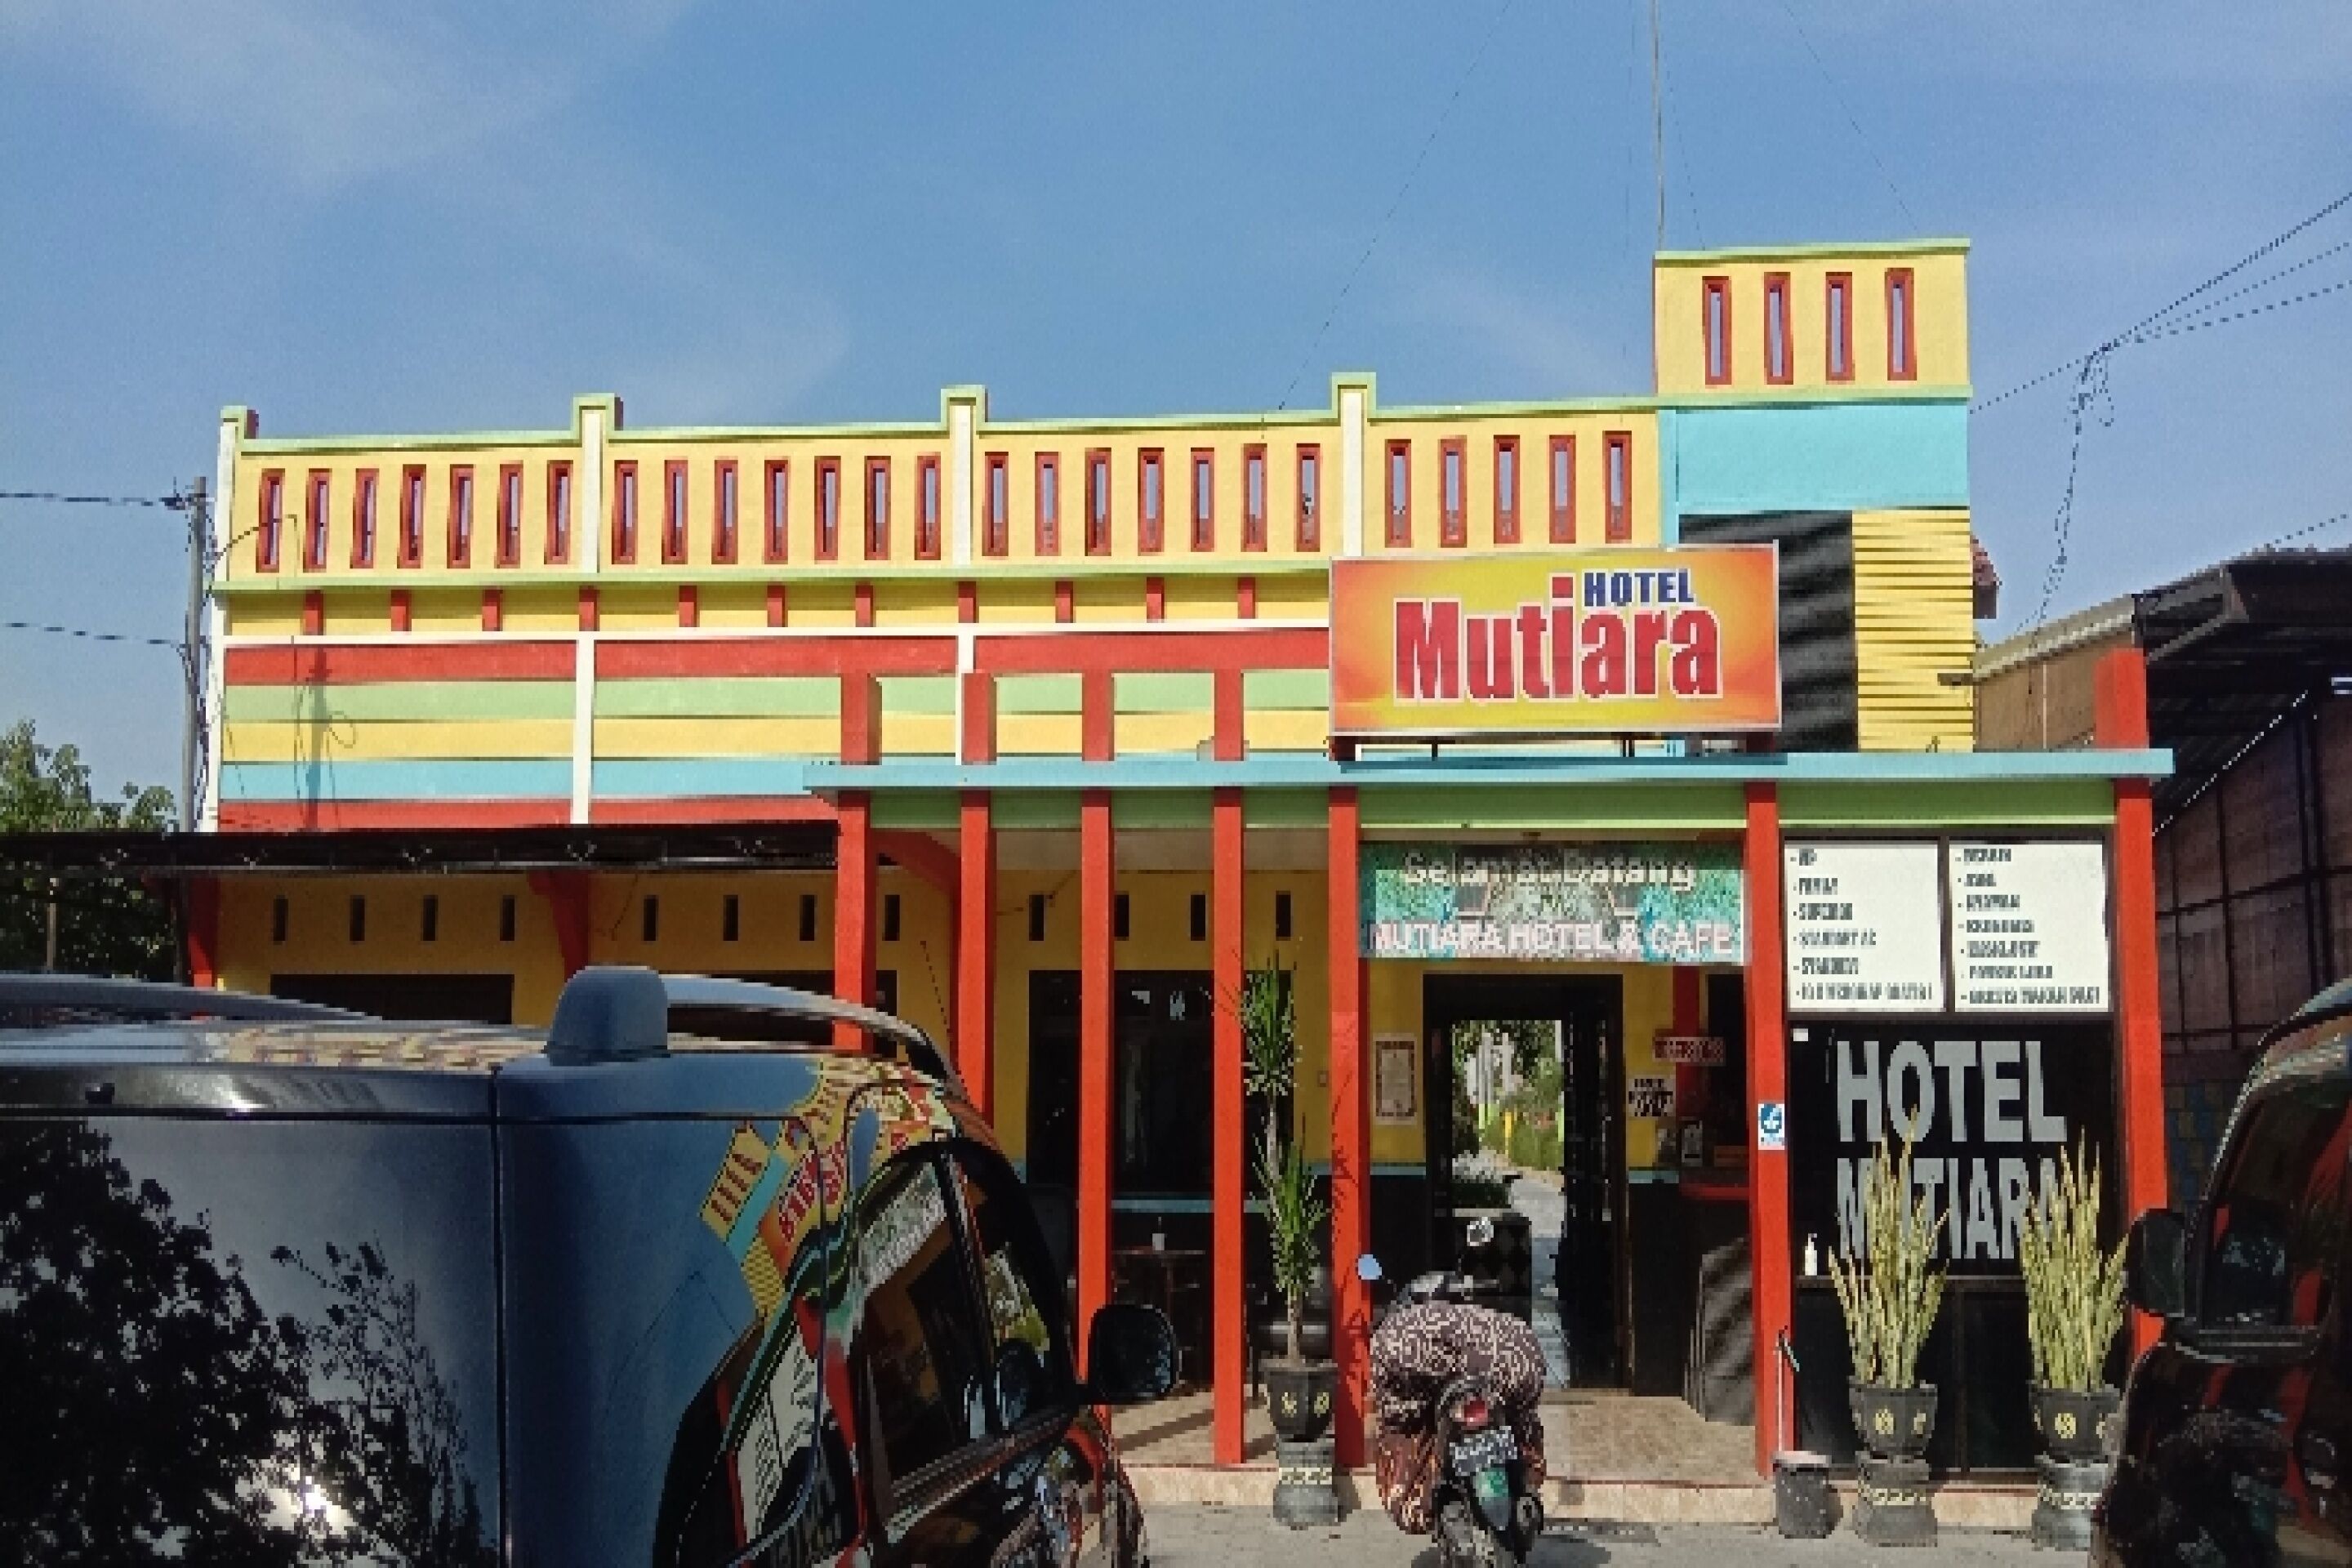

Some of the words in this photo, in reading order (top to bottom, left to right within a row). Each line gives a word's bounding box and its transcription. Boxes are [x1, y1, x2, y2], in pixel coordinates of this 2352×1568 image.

[1583, 569, 1695, 607] HOTEL
[1394, 575, 1719, 701] Mutiara
[1369, 920, 1506, 951] MUTIARA
[1510, 921, 1611, 951] HOTEL
[1651, 920, 1733, 954] CAFE
[1837, 1040, 2068, 1142] HOTEL
